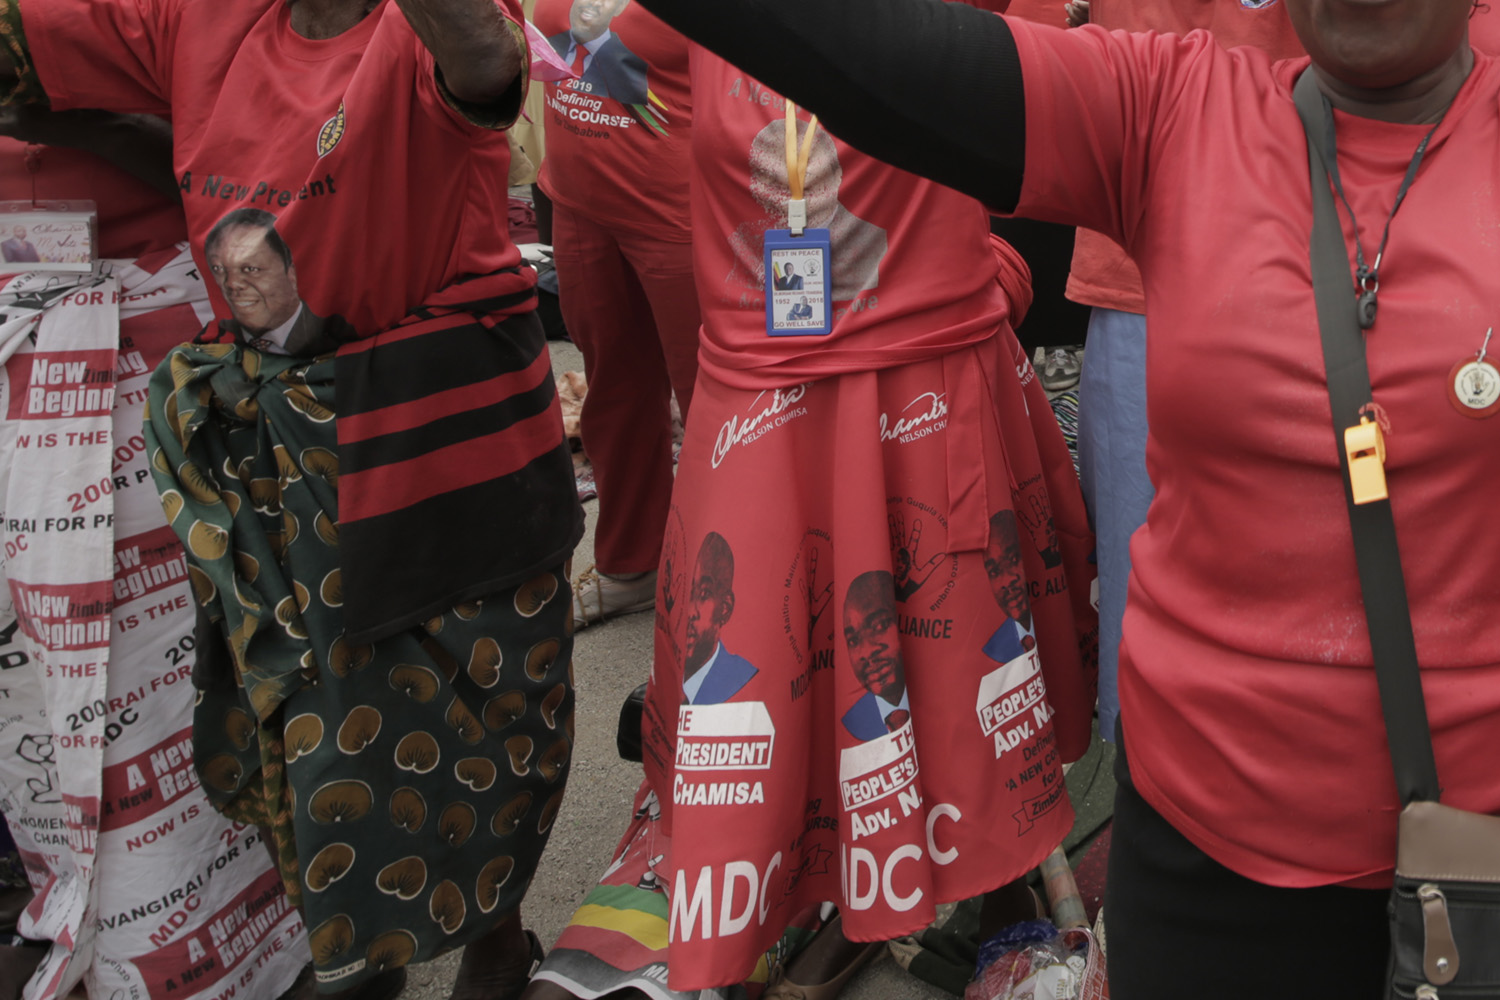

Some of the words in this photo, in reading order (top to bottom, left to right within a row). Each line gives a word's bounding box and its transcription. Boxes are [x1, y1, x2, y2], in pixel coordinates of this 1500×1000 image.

[566, 78, 593, 92] 2019
[556, 89, 603, 112] Defining
[202, 173, 251, 201] New
[62, 291, 104, 307] FOR
[30, 358, 87, 386] New
[37, 433, 58, 448] IS
[66, 430, 109, 446] THE
[742, 421, 774, 447] NELSON
[899, 425, 933, 445] NELSON
[44, 515, 86, 533] FOR
[27, 590, 70, 618] New
[117, 614, 140, 633] IS
[144, 594, 189, 621] THE
[60, 662, 98, 679] THE
[150, 664, 193, 693] FOR
[675, 736, 769, 767] PRESIDENT
[126, 763, 147, 792] A
[841, 756, 916, 807] PEOPLE'S
[1020, 761, 1043, 787] NEW
[673, 772, 765, 806] CHAMISA
[126, 818, 176, 852] NOW
[180, 804, 200, 824] IS
[206, 846, 240, 879] FOR
[148, 893, 202, 948] MDC
[187, 937, 207, 965] A
[208, 899, 249, 948] New
[255, 936, 284, 969] THE
